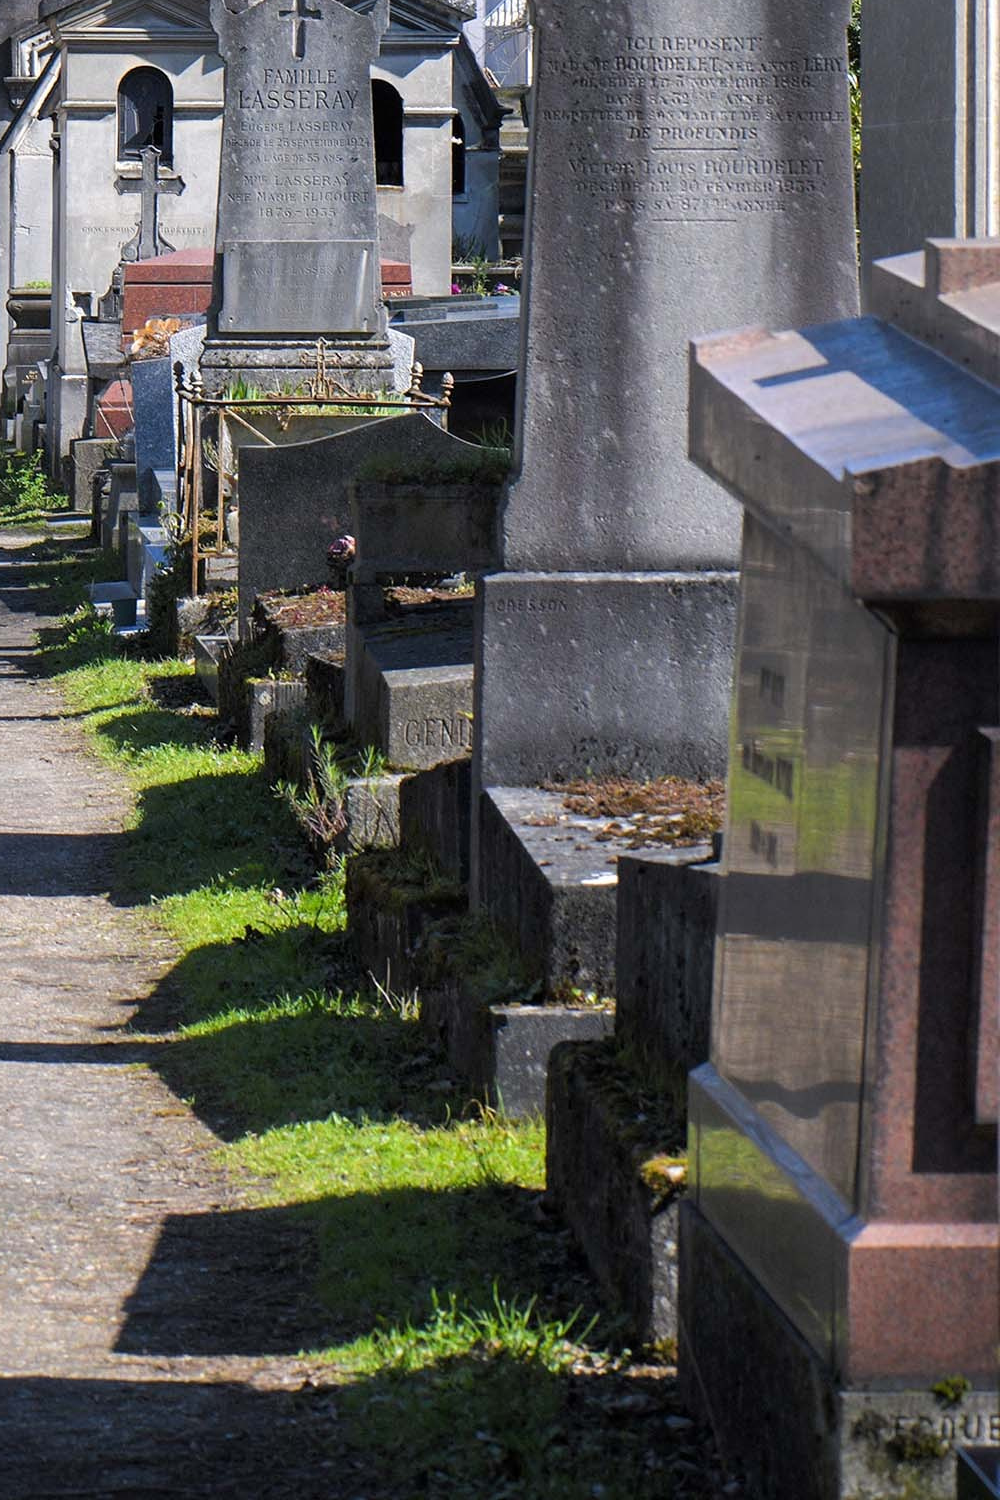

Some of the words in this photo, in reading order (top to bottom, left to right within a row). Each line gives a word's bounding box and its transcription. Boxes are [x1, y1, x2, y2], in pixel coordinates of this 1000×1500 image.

[626, 36, 655, 51] ICI
[263, 68, 337, 85] FAMILLE
[238, 90, 359, 109] LASSERAY
[289, 120, 354, 132] LASSERAY
